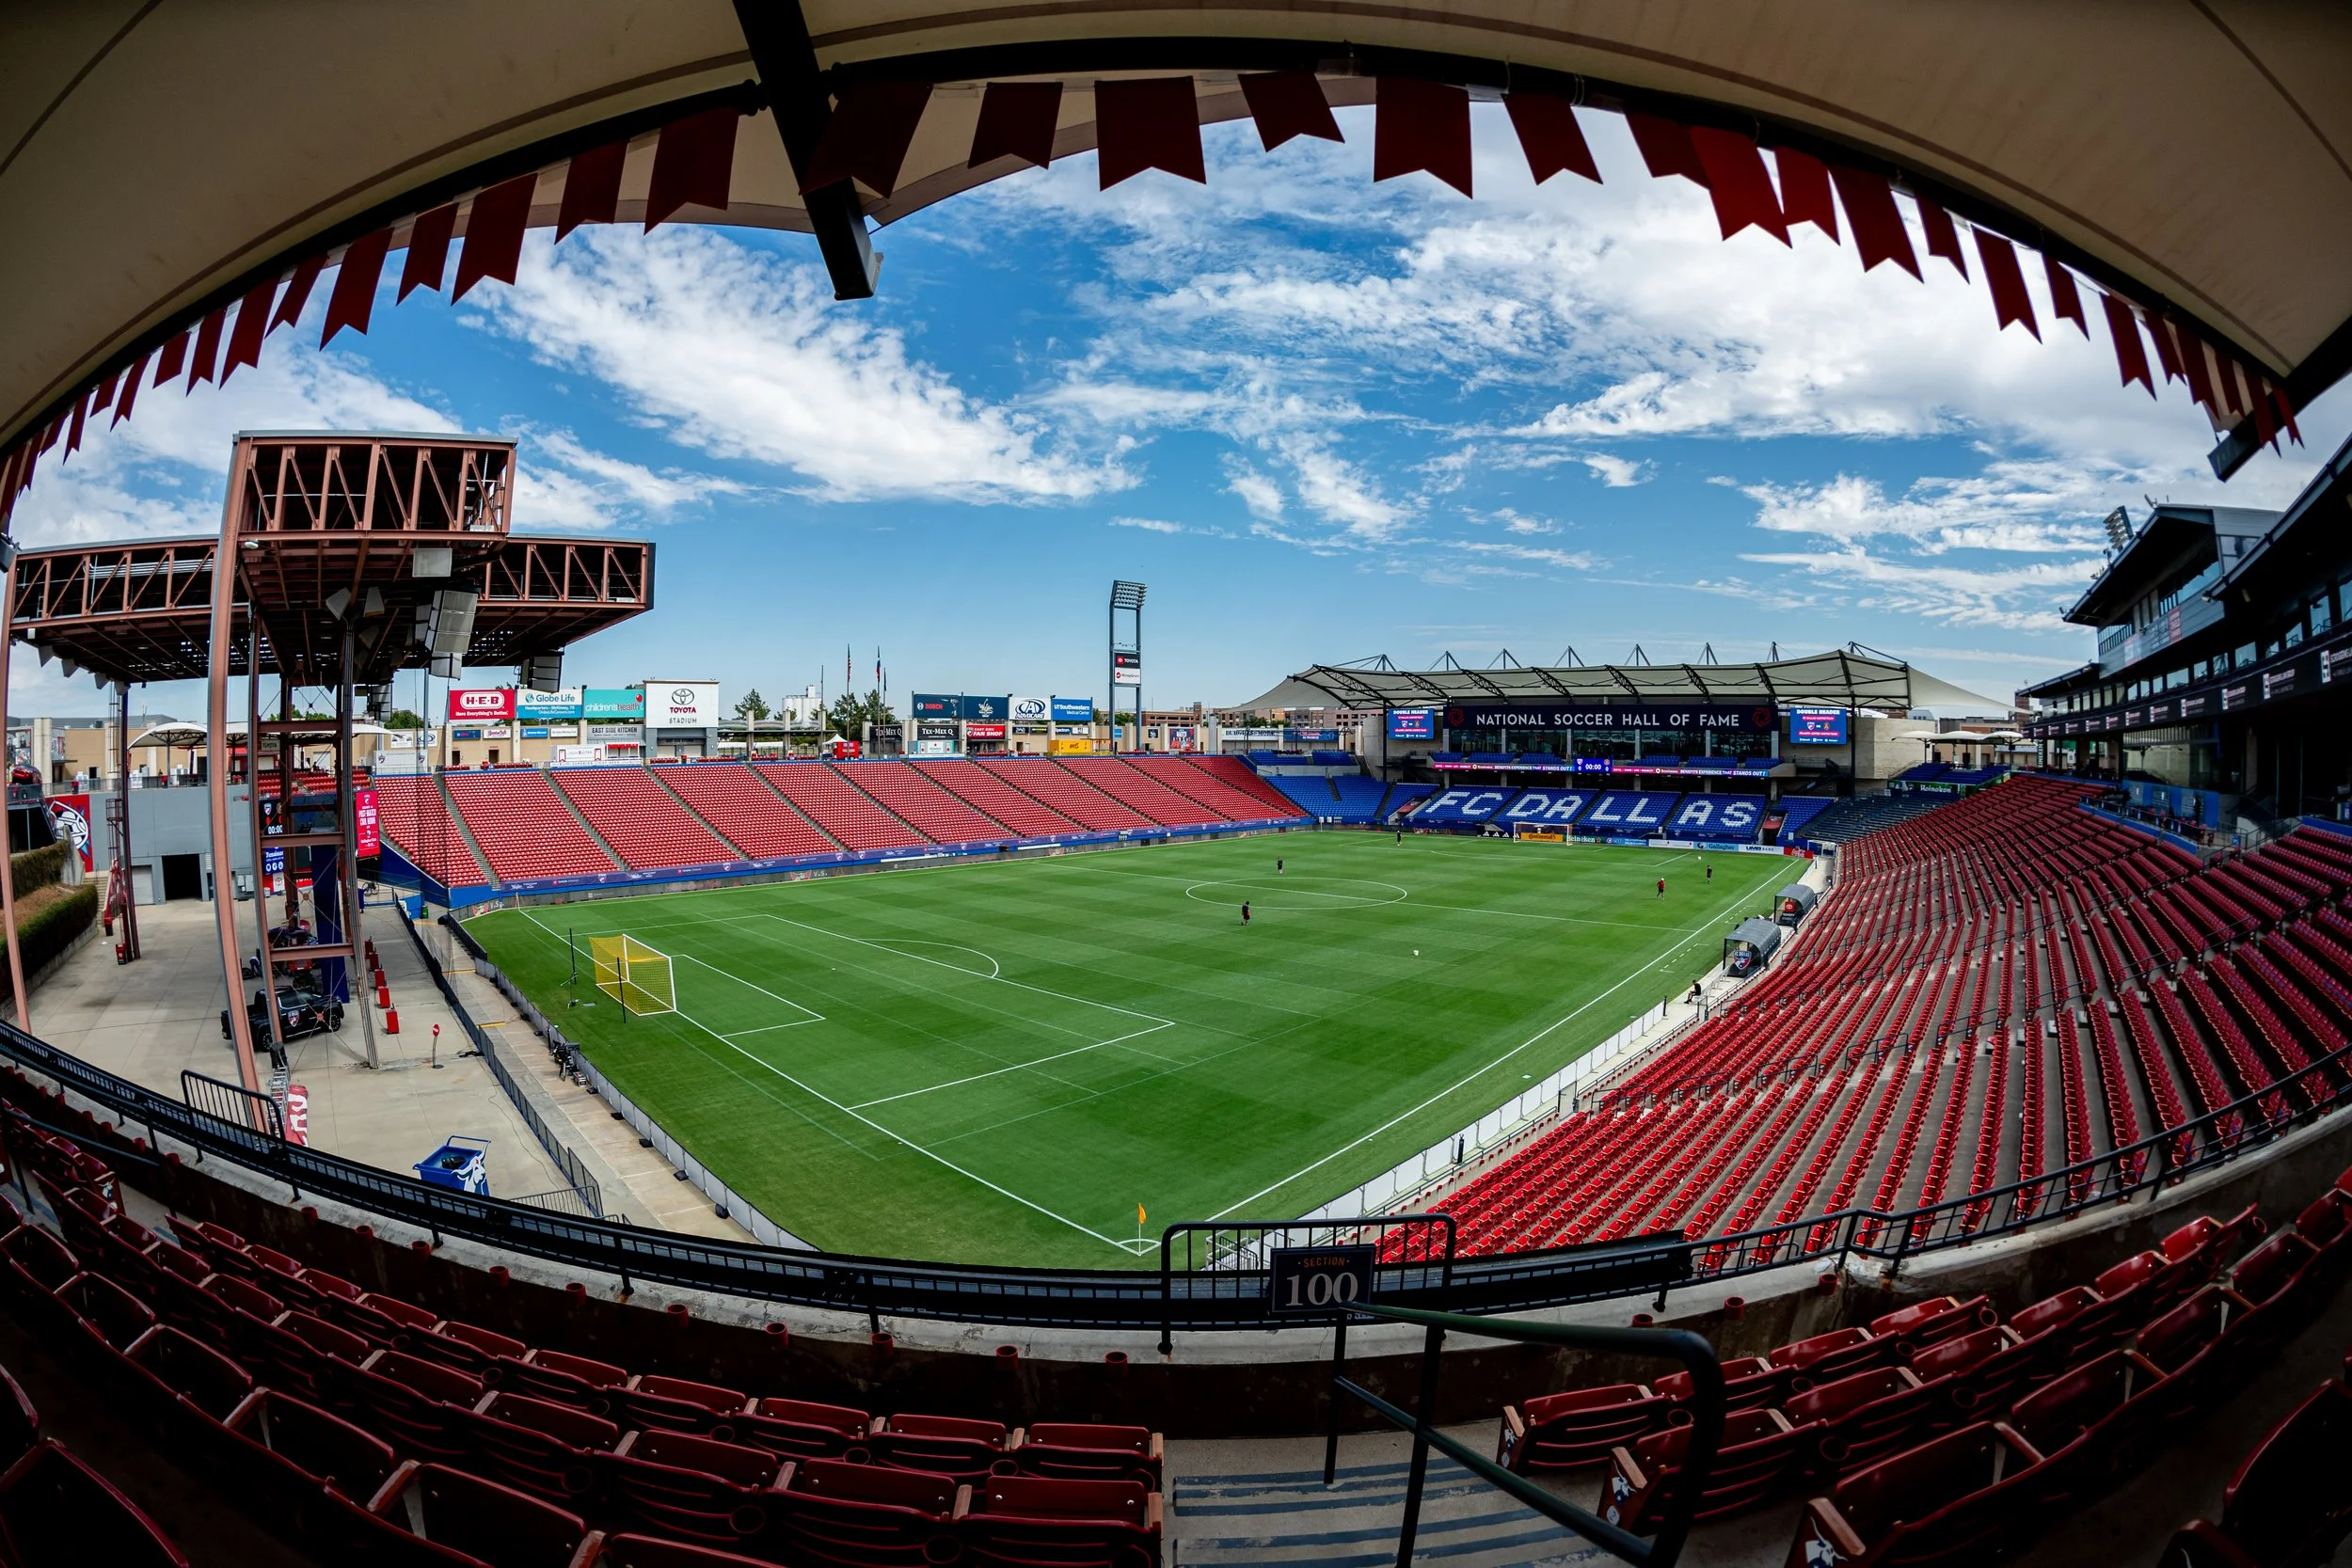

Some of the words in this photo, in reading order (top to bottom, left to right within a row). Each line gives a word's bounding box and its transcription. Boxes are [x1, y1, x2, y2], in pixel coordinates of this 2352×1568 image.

[536, 694, 560, 703] Globe
[1476, 714, 1545, 725] NATIONAL
[1554, 714, 1613, 725] SOCCER
[1622, 714, 1660, 726] HALL
[1670, 714, 1690, 726] OF
[1699, 714, 1740, 726] FAME
[1425, 792, 1502, 816] FC
[1506, 794, 1756, 827] DALLAS
[1303, 1257, 1345, 1268] SECTION
[1286, 1272, 1358, 1307] 100
